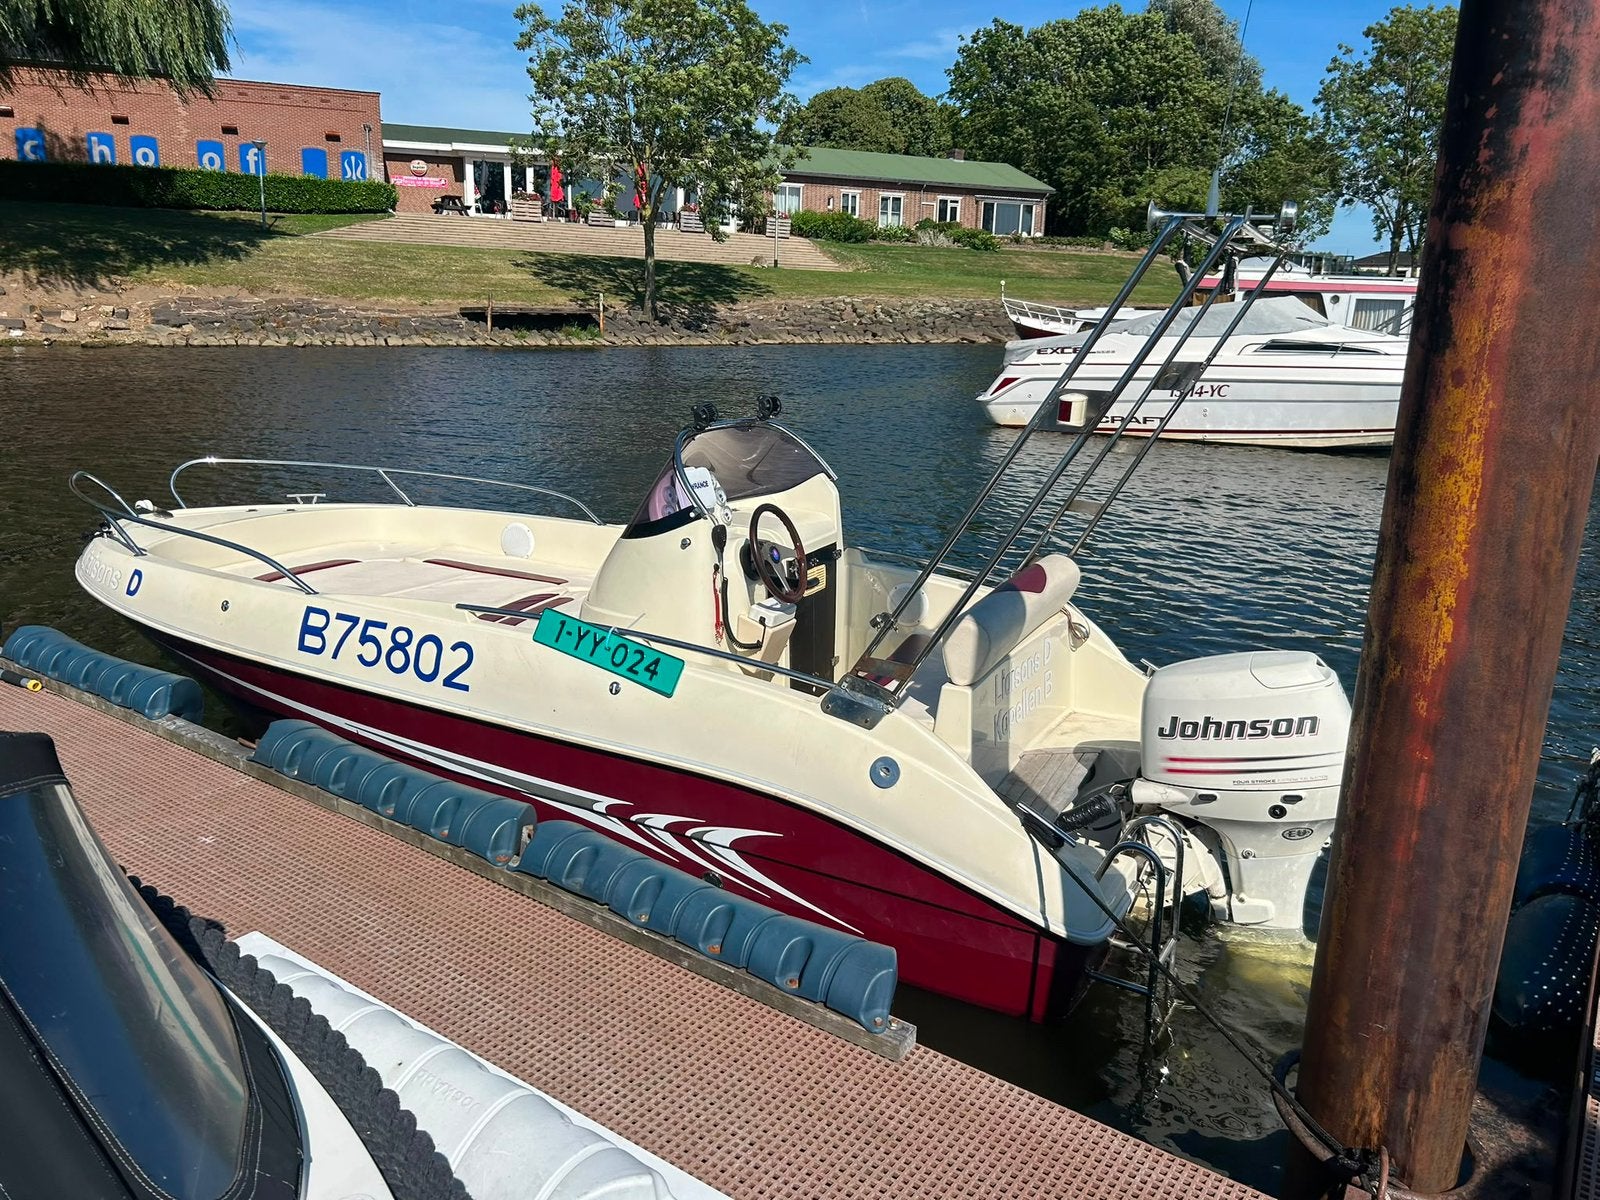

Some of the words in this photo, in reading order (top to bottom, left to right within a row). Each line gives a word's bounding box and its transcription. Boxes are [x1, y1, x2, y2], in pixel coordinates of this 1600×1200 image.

[126, 569, 143, 597] D
[298, 605, 474, 692] B75802
[554, 619, 662, 682] 1-YY-024
[1157, 715, 1320, 740] Johnson
